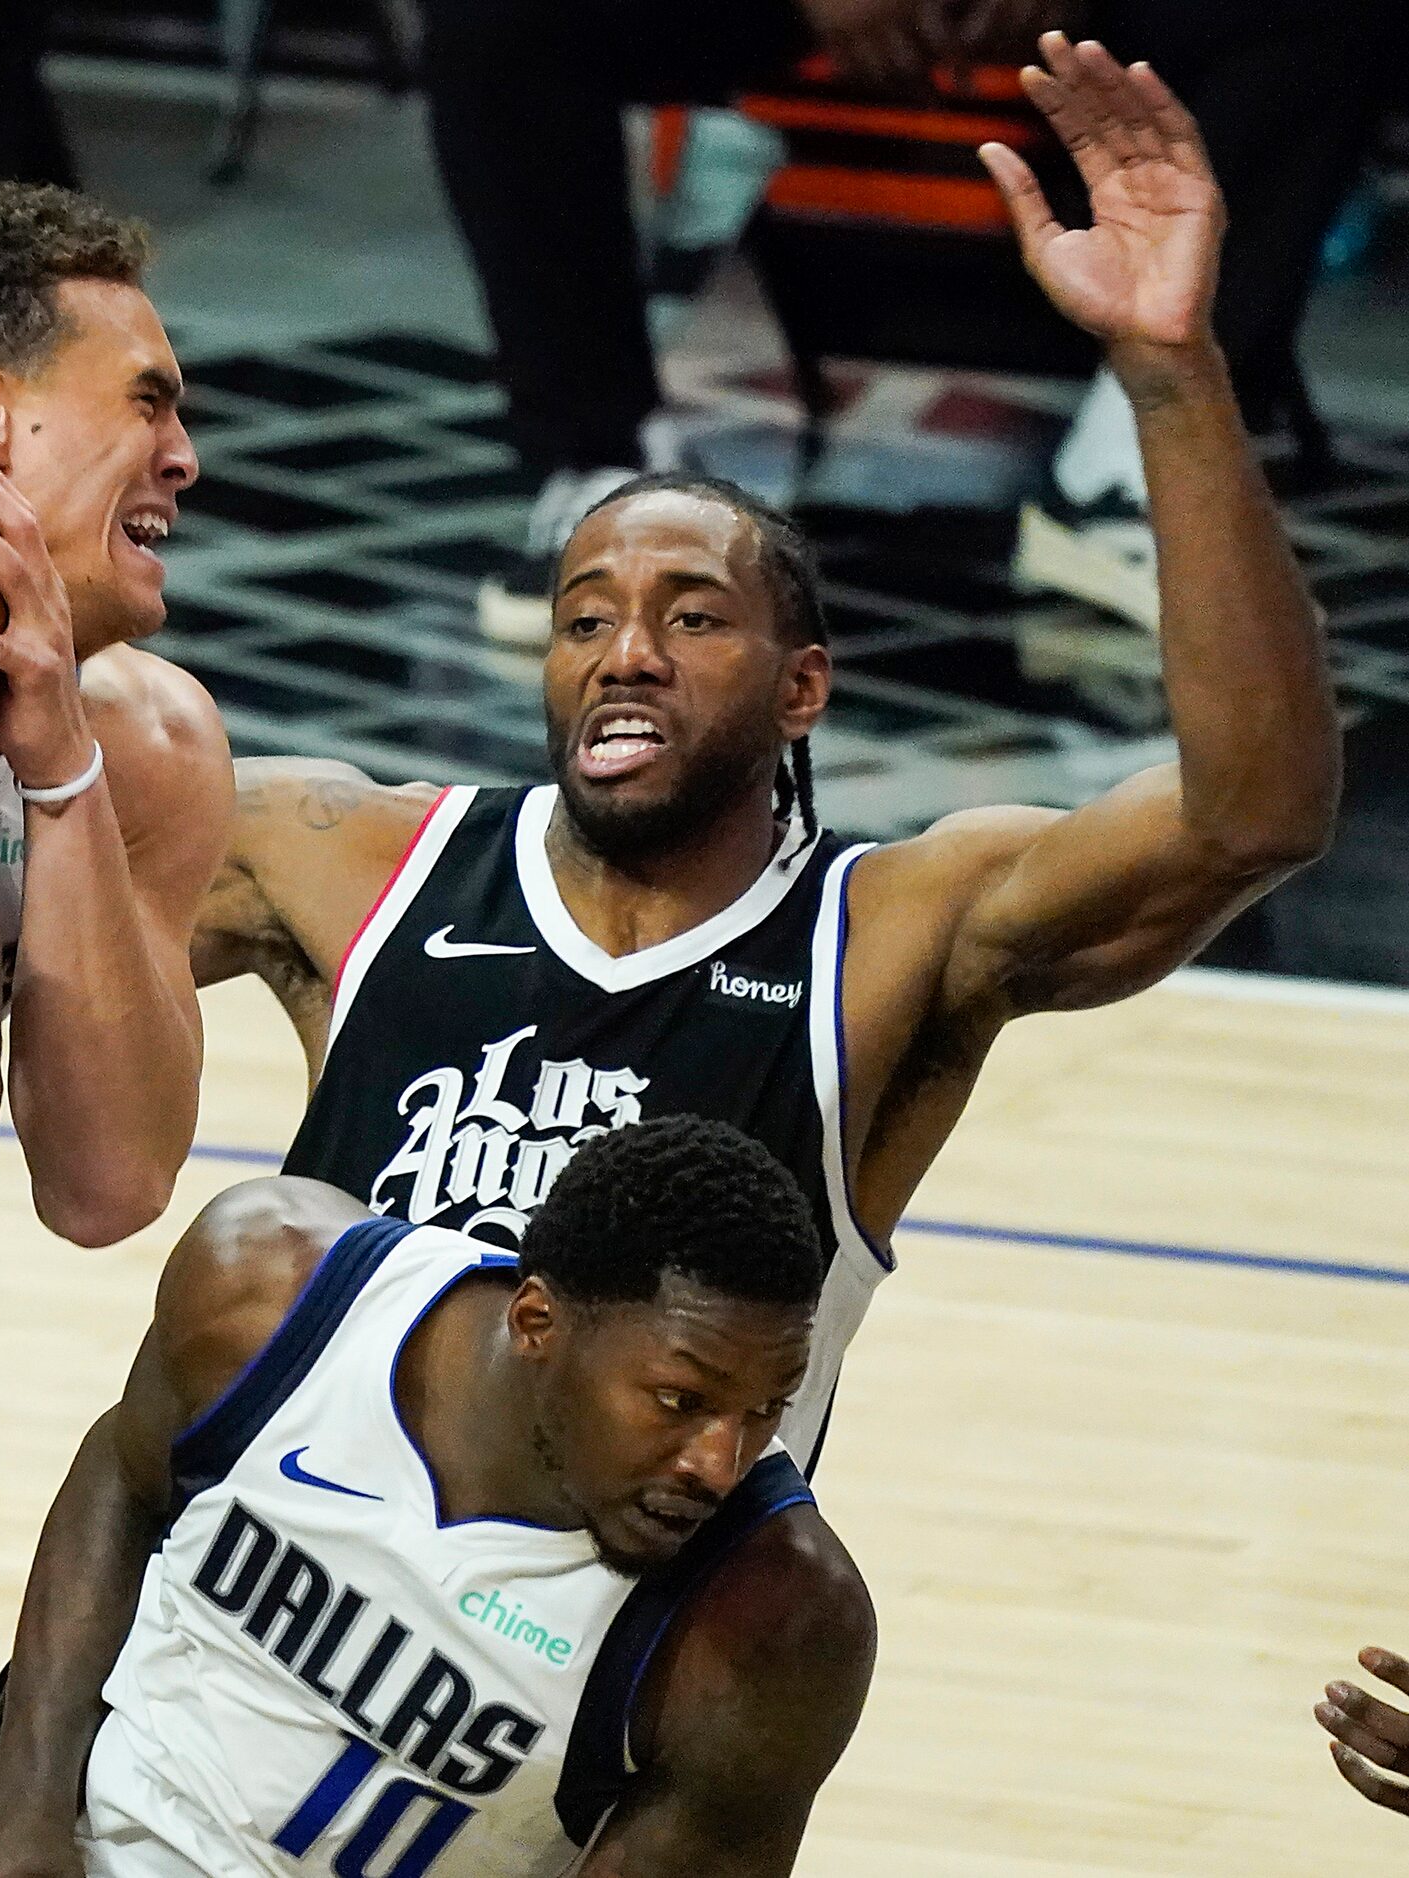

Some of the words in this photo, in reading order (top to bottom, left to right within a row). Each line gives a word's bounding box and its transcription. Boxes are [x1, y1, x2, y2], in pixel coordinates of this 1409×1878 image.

[710, 960, 803, 1009] honey
[455, 1025, 651, 1133] Los
[189, 1495, 547, 1796] DALLAS
[458, 1590, 572, 1665] chime
[271, 1732, 480, 1878] 10
